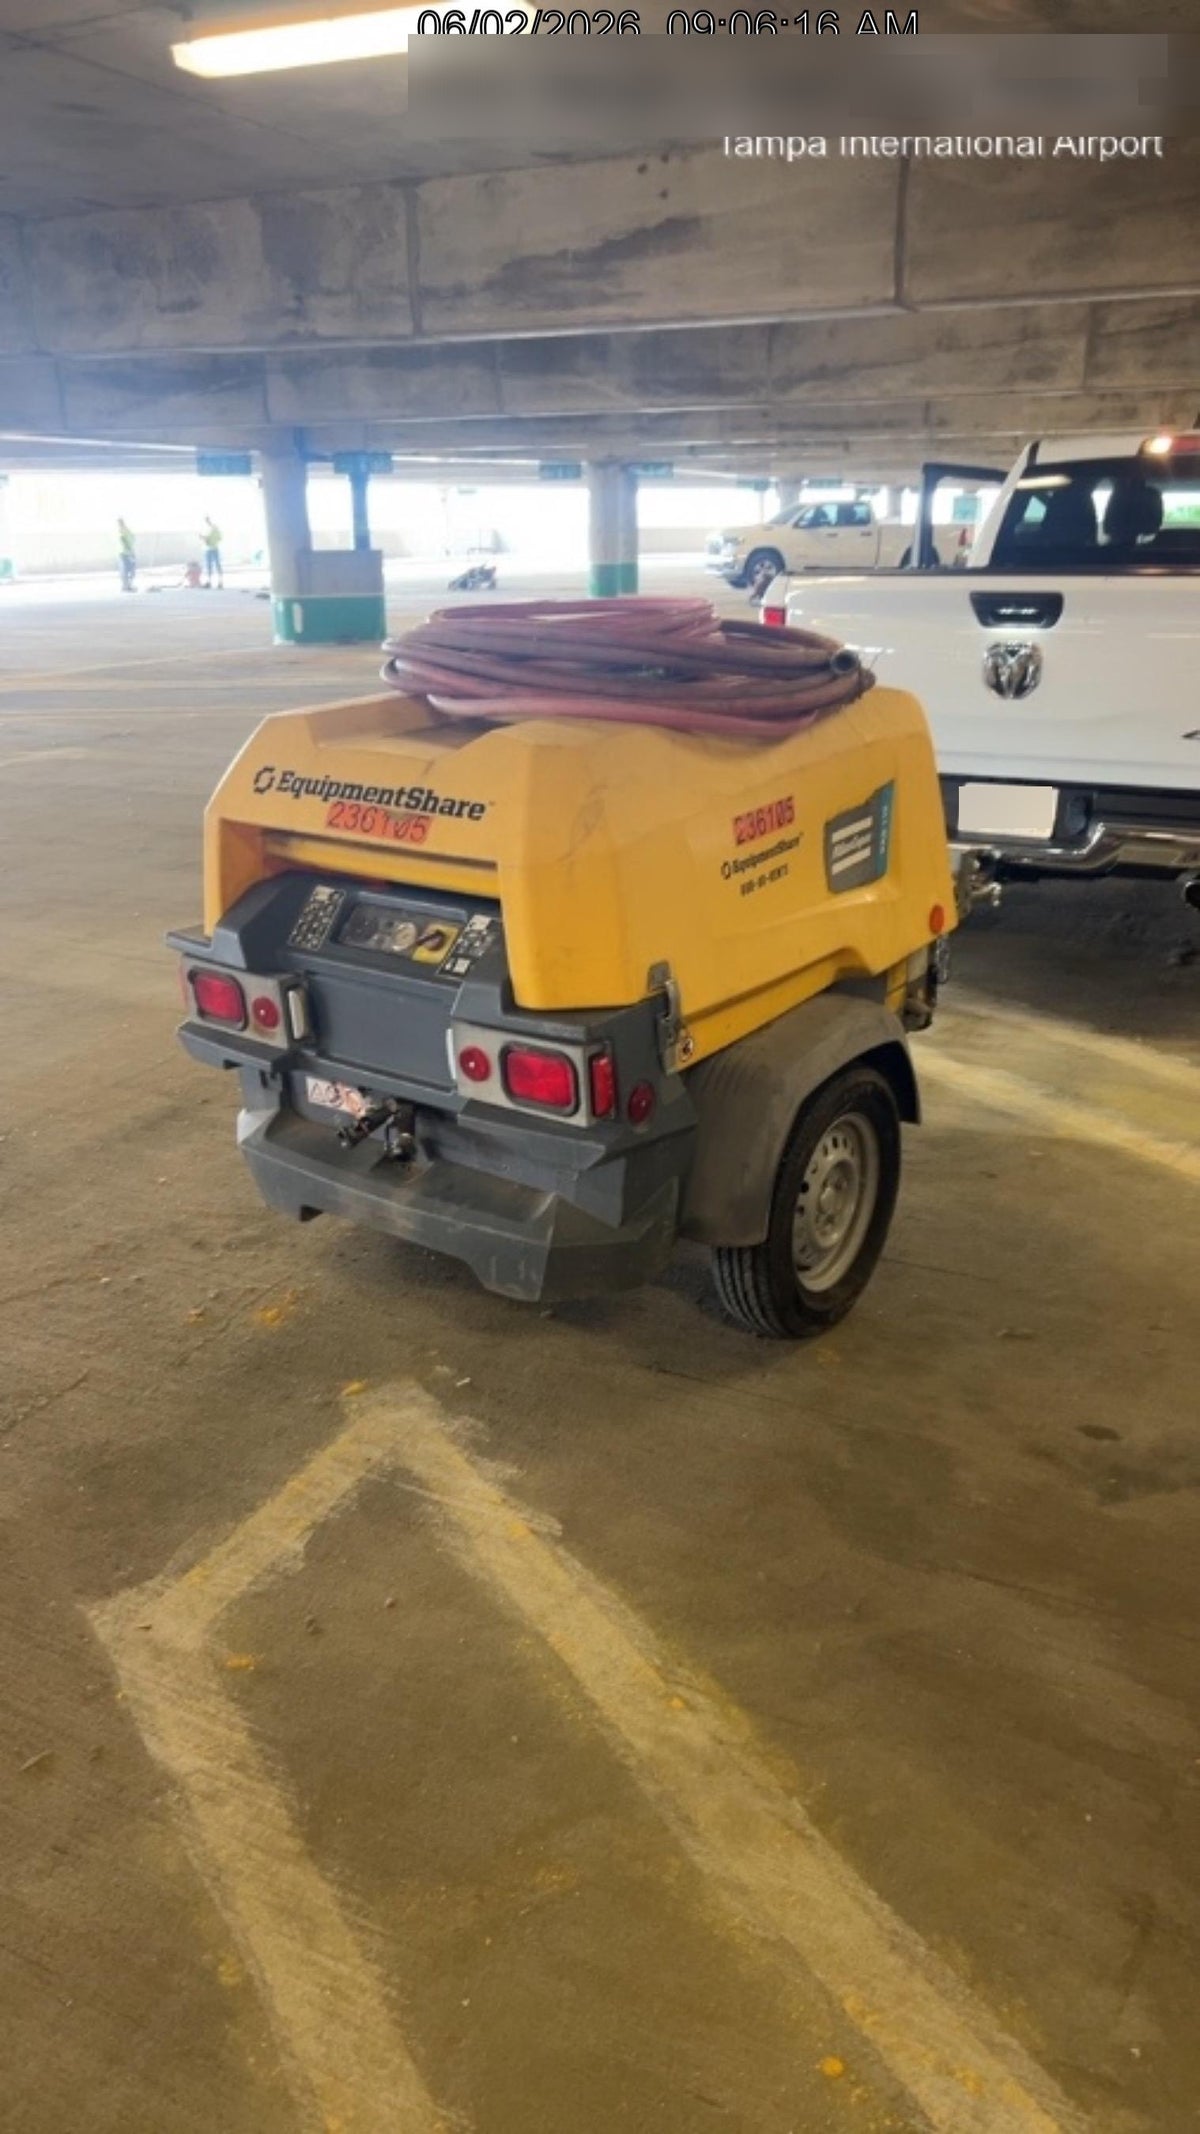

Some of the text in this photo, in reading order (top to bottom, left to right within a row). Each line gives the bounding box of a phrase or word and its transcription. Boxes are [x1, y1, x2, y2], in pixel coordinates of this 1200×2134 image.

[275, 769, 487, 821] EquipmentShare
[734, 795, 795, 846] 236105
[325, 800, 431, 843] 236105
